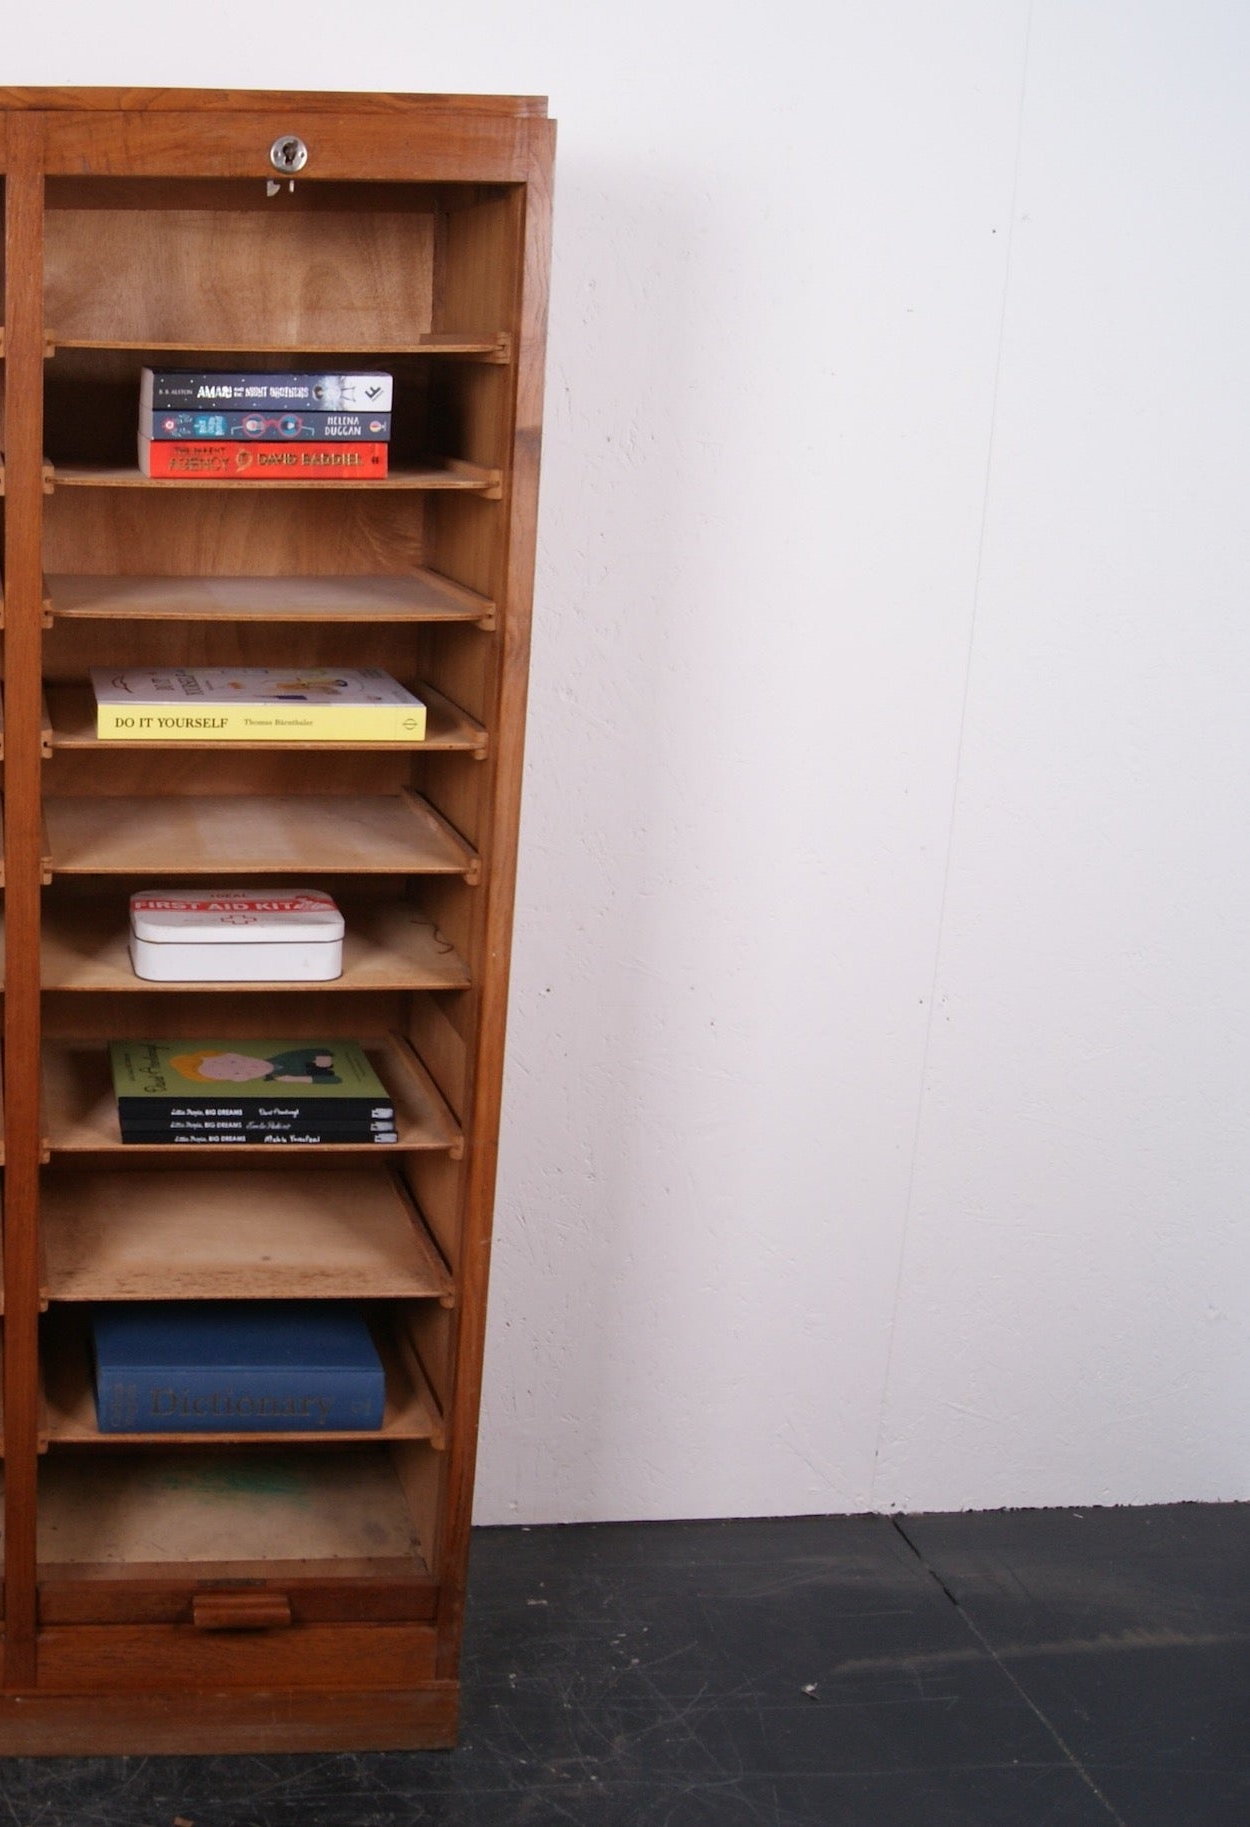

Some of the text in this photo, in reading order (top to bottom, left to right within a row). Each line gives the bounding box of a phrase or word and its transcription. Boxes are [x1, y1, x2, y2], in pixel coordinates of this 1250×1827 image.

[197, 385, 232, 399] AMARI
[245, 386, 268, 398] NIGHT
[270, 386, 309, 399] BROTHERS
[328, 416, 359, 426] HELENA
[325, 426, 361, 436] DUGGAN
[169, 456, 230, 471] AGENCY
[257, 454, 298, 466] DAVID
[115, 717, 228, 729] DO IT YOURSELF
[244, 718, 272, 726] Thomas
[135, 901, 293, 911] FIRST AID KIT
[152, 1386, 333, 1424] Dictionary
